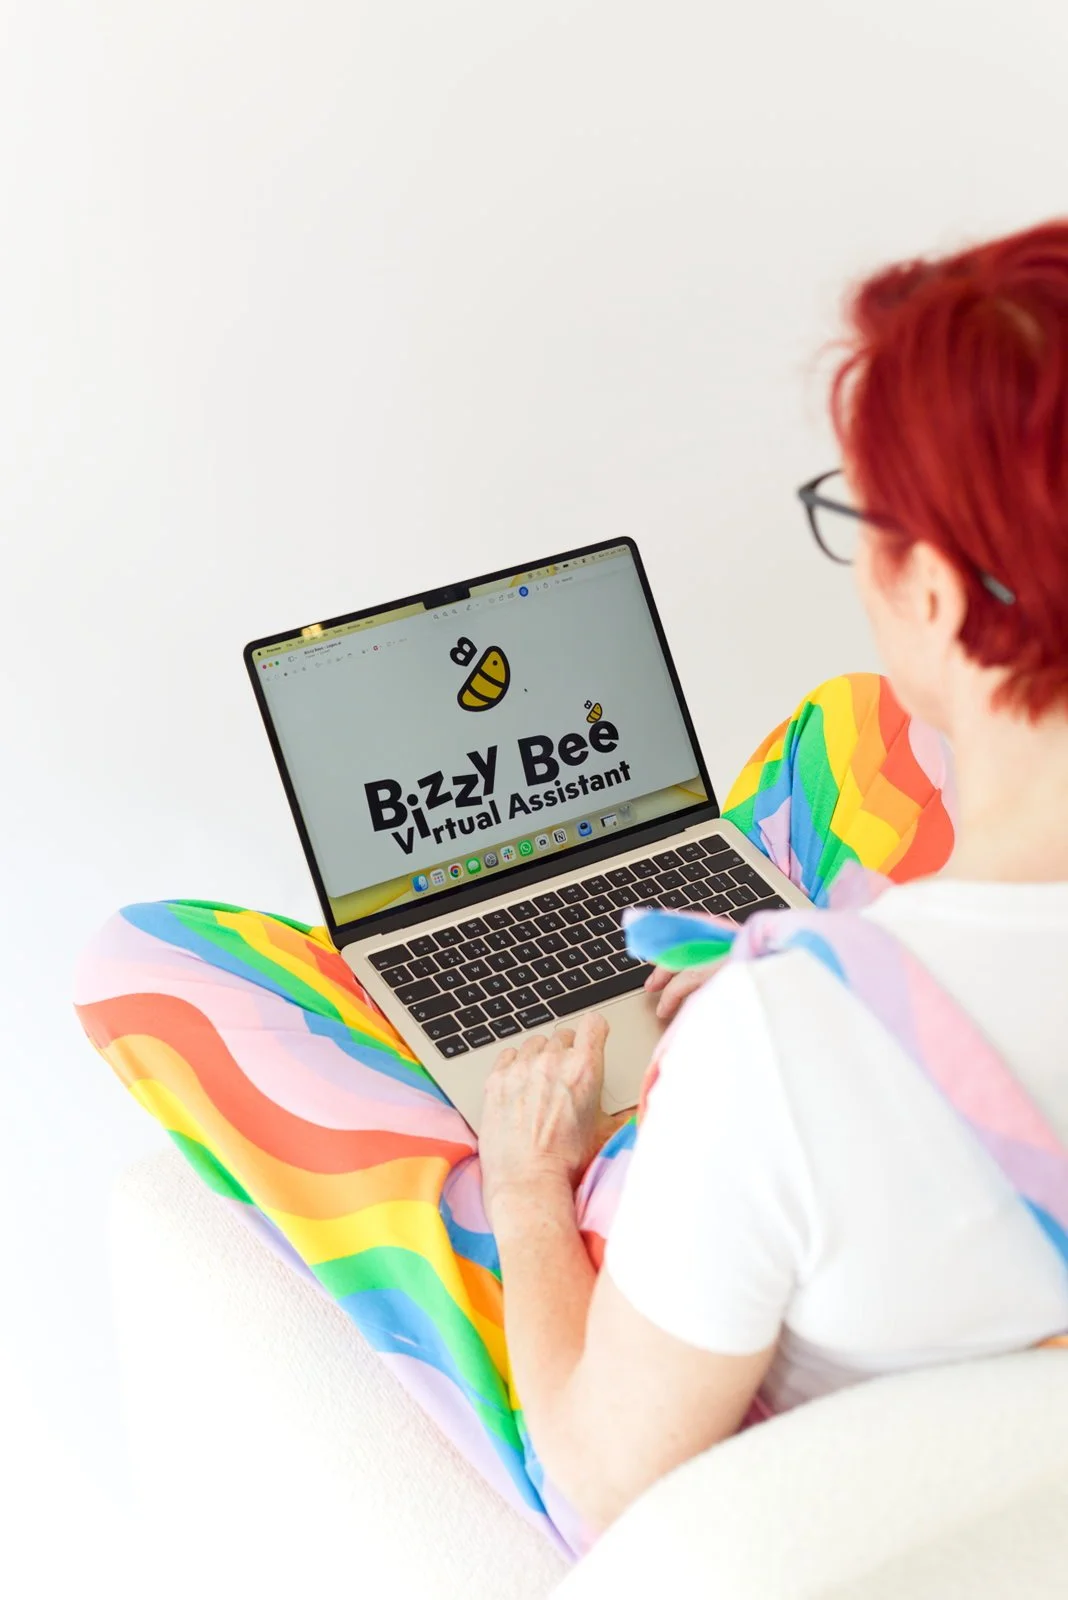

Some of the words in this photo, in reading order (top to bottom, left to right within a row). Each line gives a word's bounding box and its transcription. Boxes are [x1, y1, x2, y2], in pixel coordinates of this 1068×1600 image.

[364, 745, 498, 838] Bizzy
[518, 720, 620, 786] Bee
[391, 795, 502, 855] Virtual
[508, 760, 631, 820] Assistant
